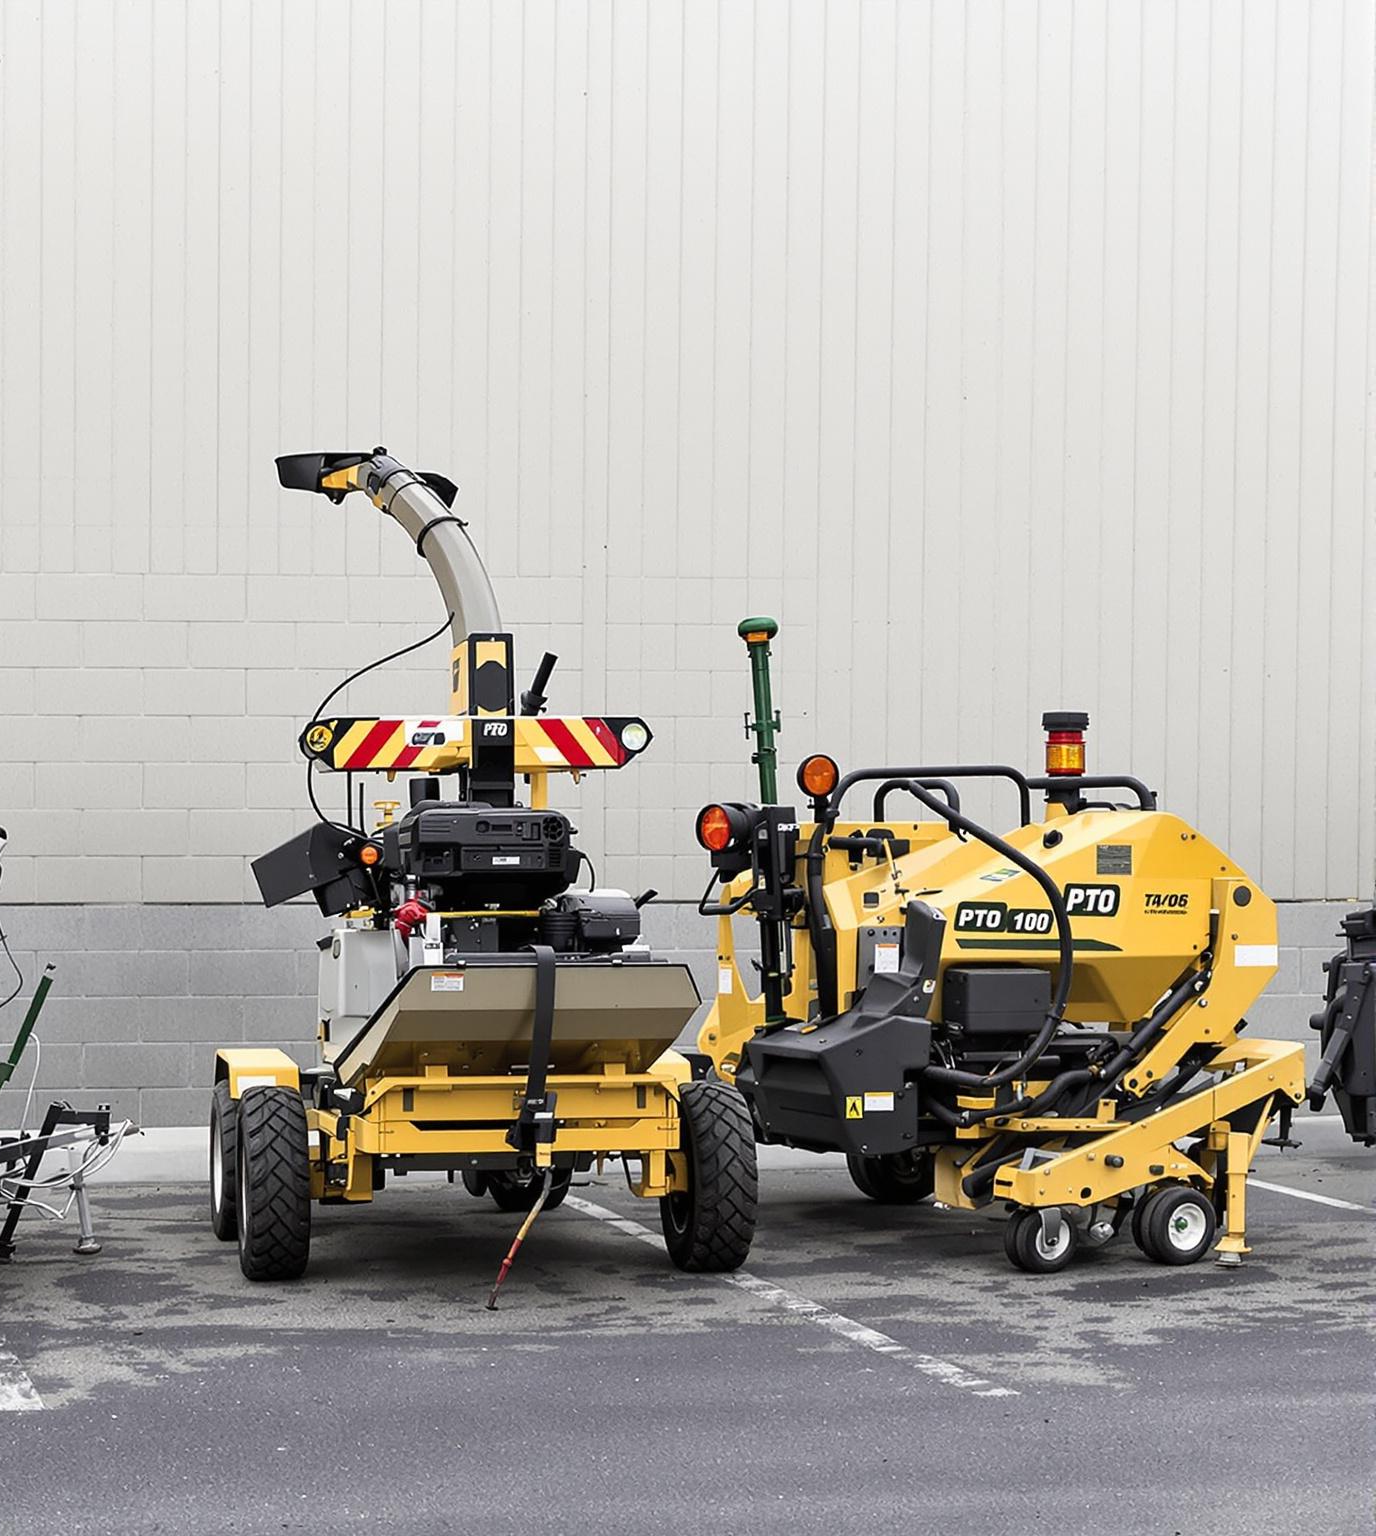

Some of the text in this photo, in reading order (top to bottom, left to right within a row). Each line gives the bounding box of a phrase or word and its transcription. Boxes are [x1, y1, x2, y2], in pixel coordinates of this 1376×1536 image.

[483, 722, 507, 736] PTO
[1066, 888, 1116, 913] PTO
[958, 909, 1050, 932] PTO 100
